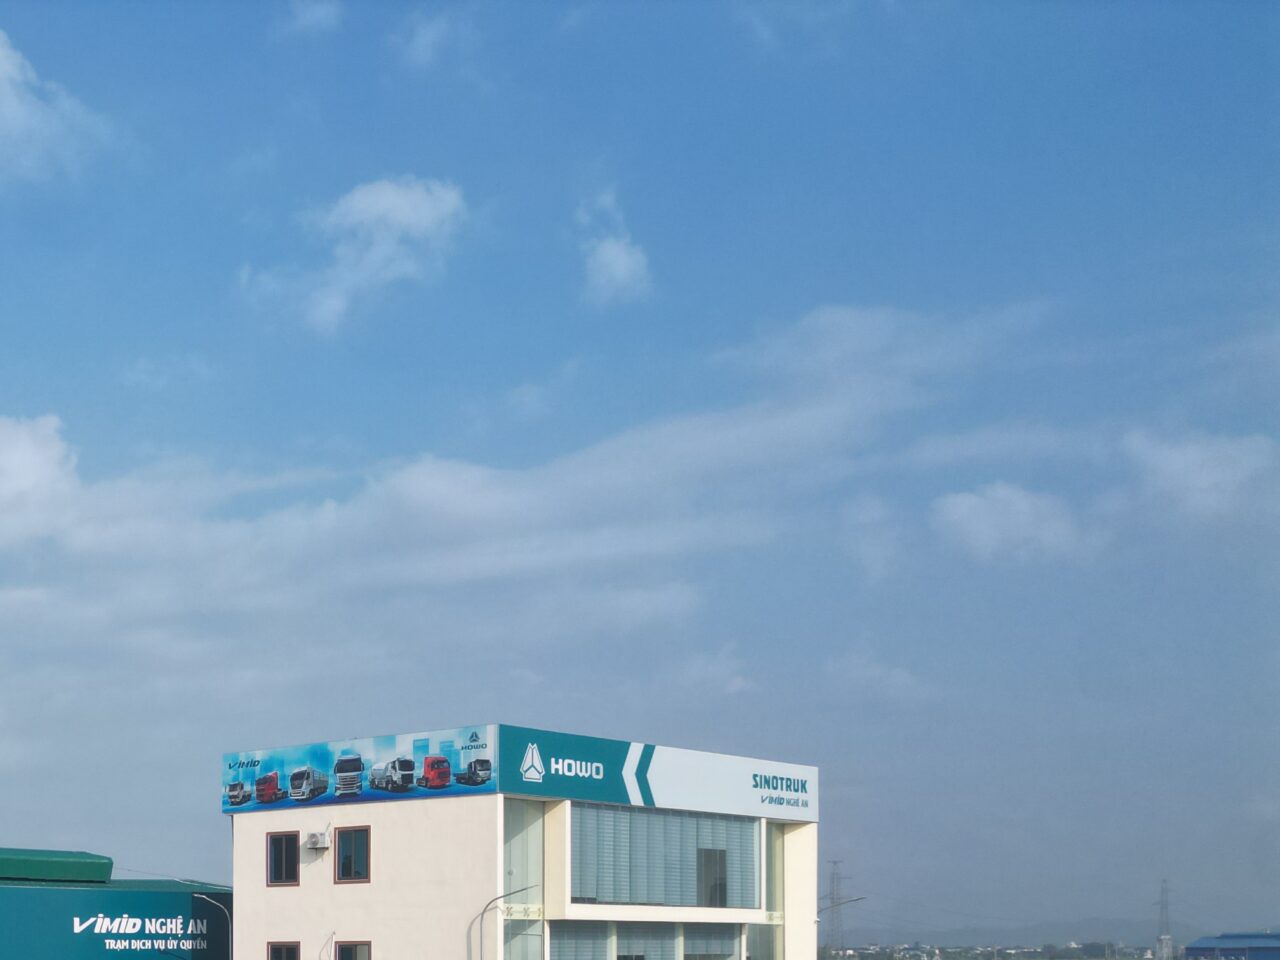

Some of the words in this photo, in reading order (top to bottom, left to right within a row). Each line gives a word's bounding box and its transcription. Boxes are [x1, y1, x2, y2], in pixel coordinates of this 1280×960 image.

[461, 743, 488, 751] HOWO
[549, 757, 605, 780] HOWO
[752, 773, 808, 794] SINOTRUK
[145, 915, 183, 937] NGHỆ
[187, 919, 207, 934] AN
[105, 939, 129, 951] TRẠM
[131, 939, 151, 951] DỊCH
[153, 939, 165, 951] VỤ
